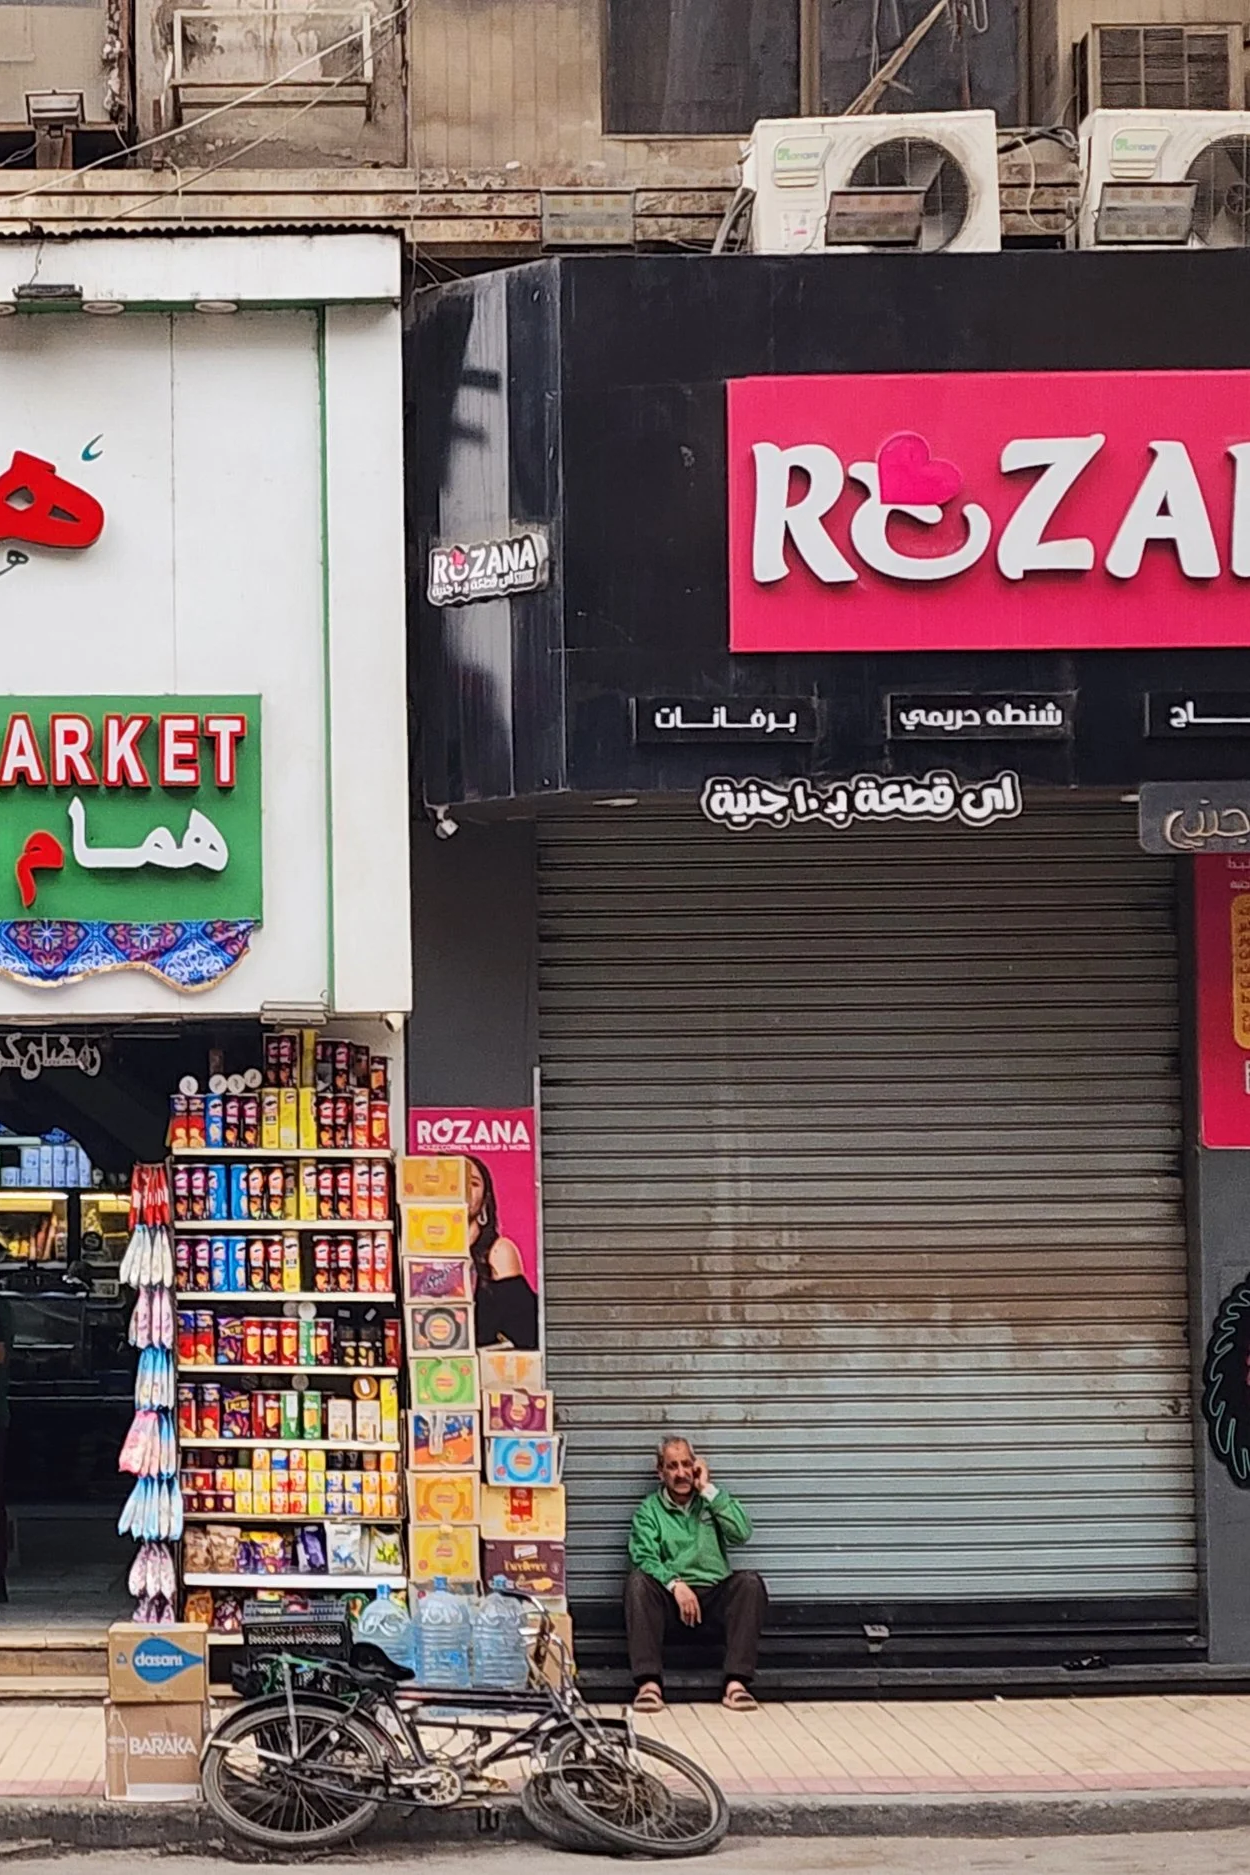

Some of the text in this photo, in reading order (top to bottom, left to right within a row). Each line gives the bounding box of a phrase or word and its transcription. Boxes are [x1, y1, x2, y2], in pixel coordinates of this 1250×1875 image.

[751, 430, 1250, 584] ROZA
[433, 540, 536, 584] ROZANA
[655, 705, 797, 733] برفانات
[899, 702, 1063, 731] شنطه حريمي
[710, 784, 789, 823] جنية
[854, 776, 955, 815] قطعة
[16, 795, 229, 907] همام
[21, 1032, 101, 1080] رمضان
[417, 1118, 530, 1143] ROZANA
[135, 1652, 183, 1666] dasani
[130, 1736, 198, 1756] BARAKA
